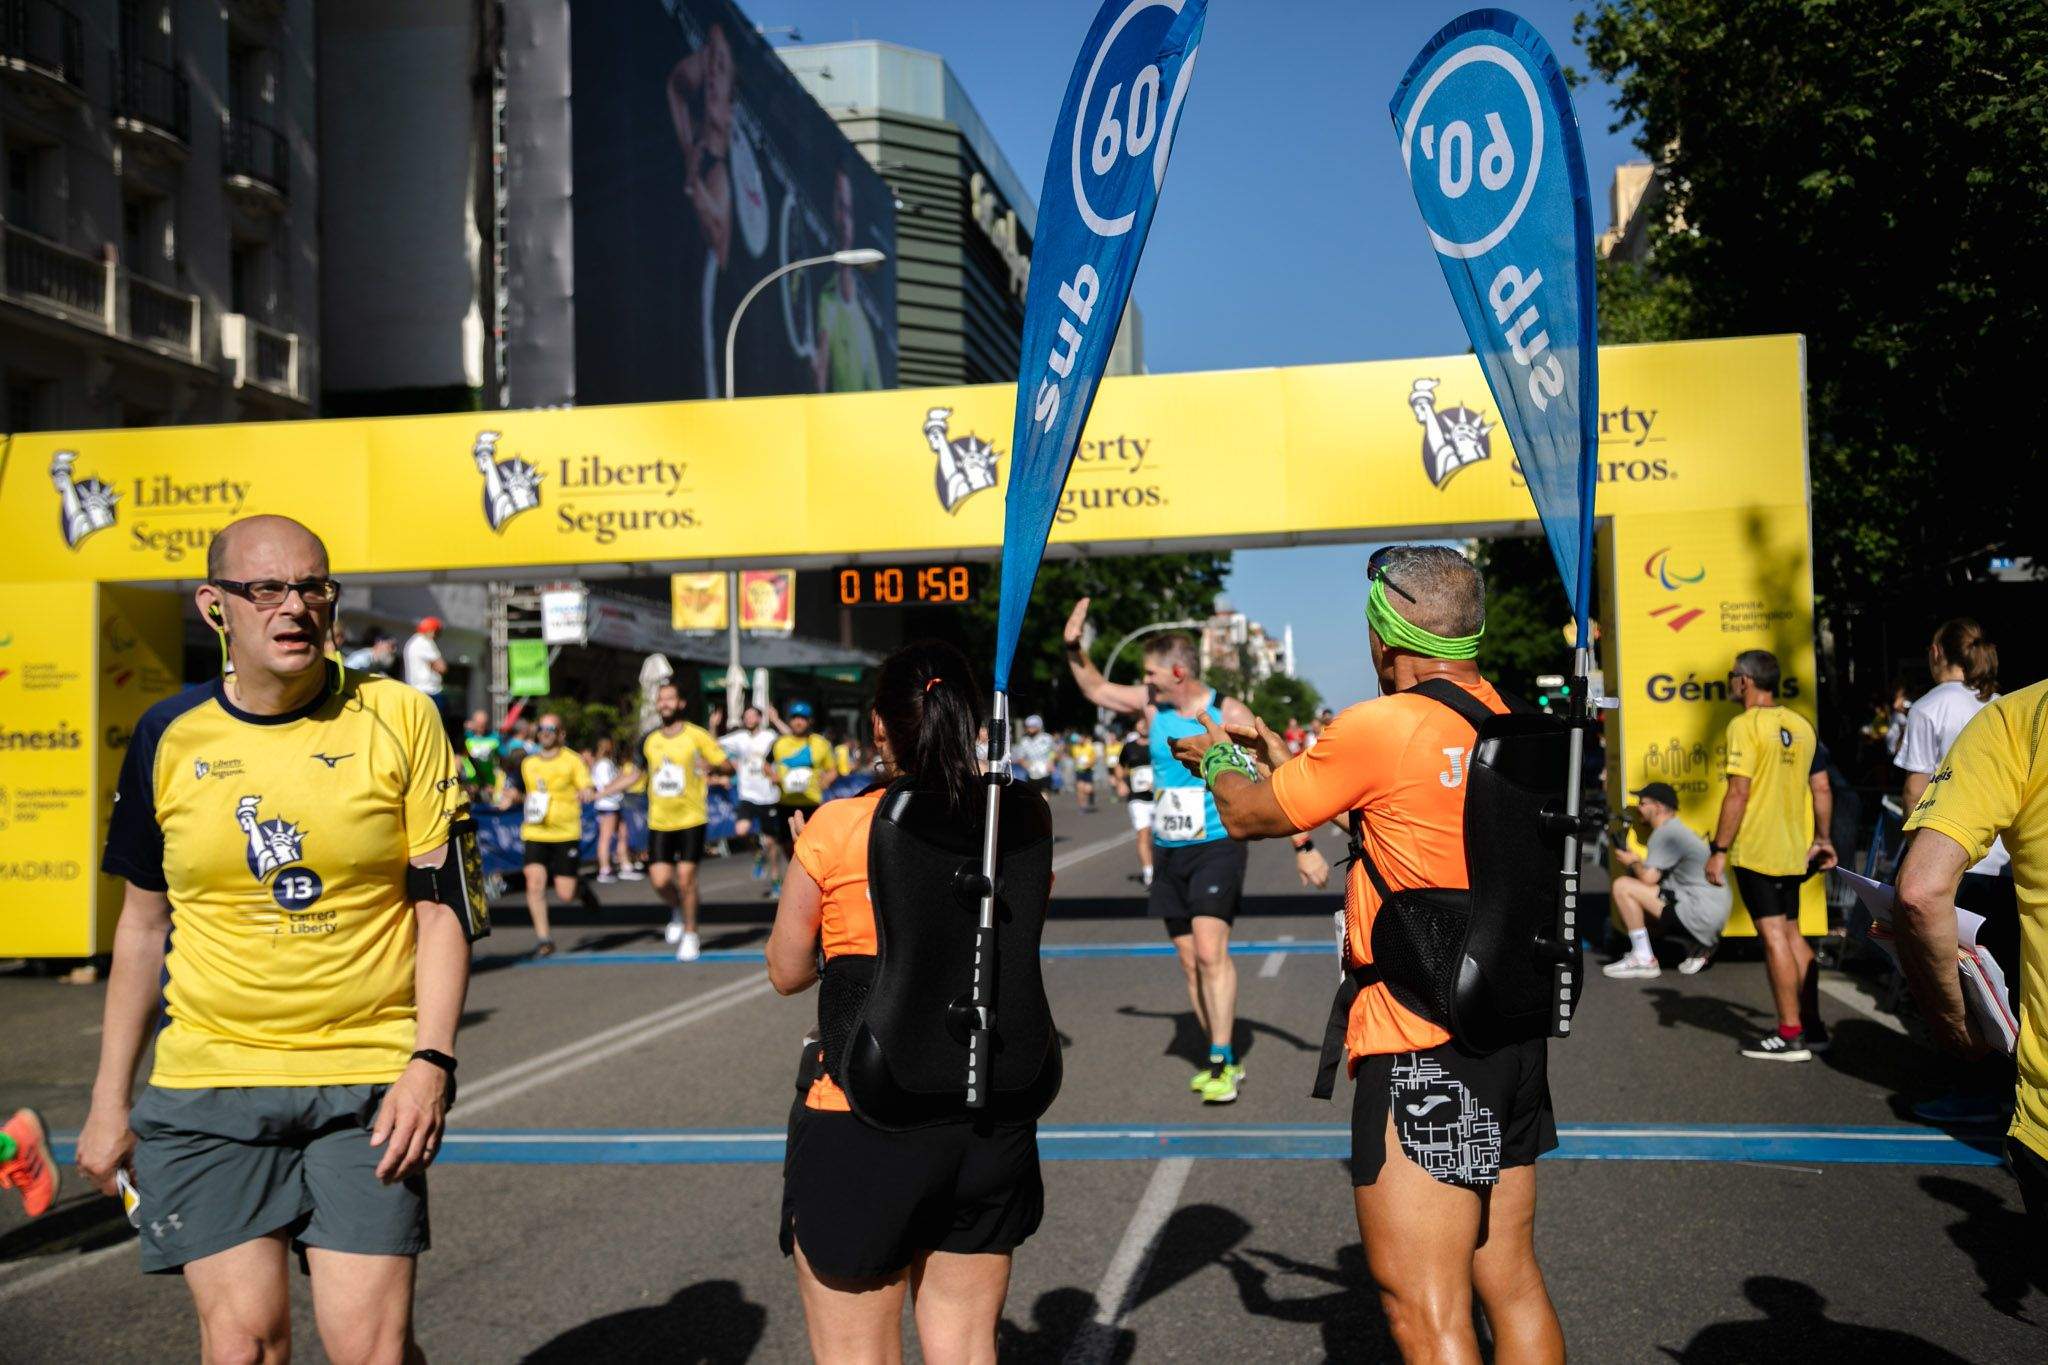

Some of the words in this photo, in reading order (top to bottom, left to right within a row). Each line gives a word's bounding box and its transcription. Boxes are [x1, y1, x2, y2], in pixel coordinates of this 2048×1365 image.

[1034, 263, 1100, 433] sub
[1077, 434, 1151, 474] erty
[134, 474, 250, 515] Liberty
[560, 455, 688, 496] Liberty
[281, 875, 314, 900] 13
[290, 923, 337, 935] Liberty
